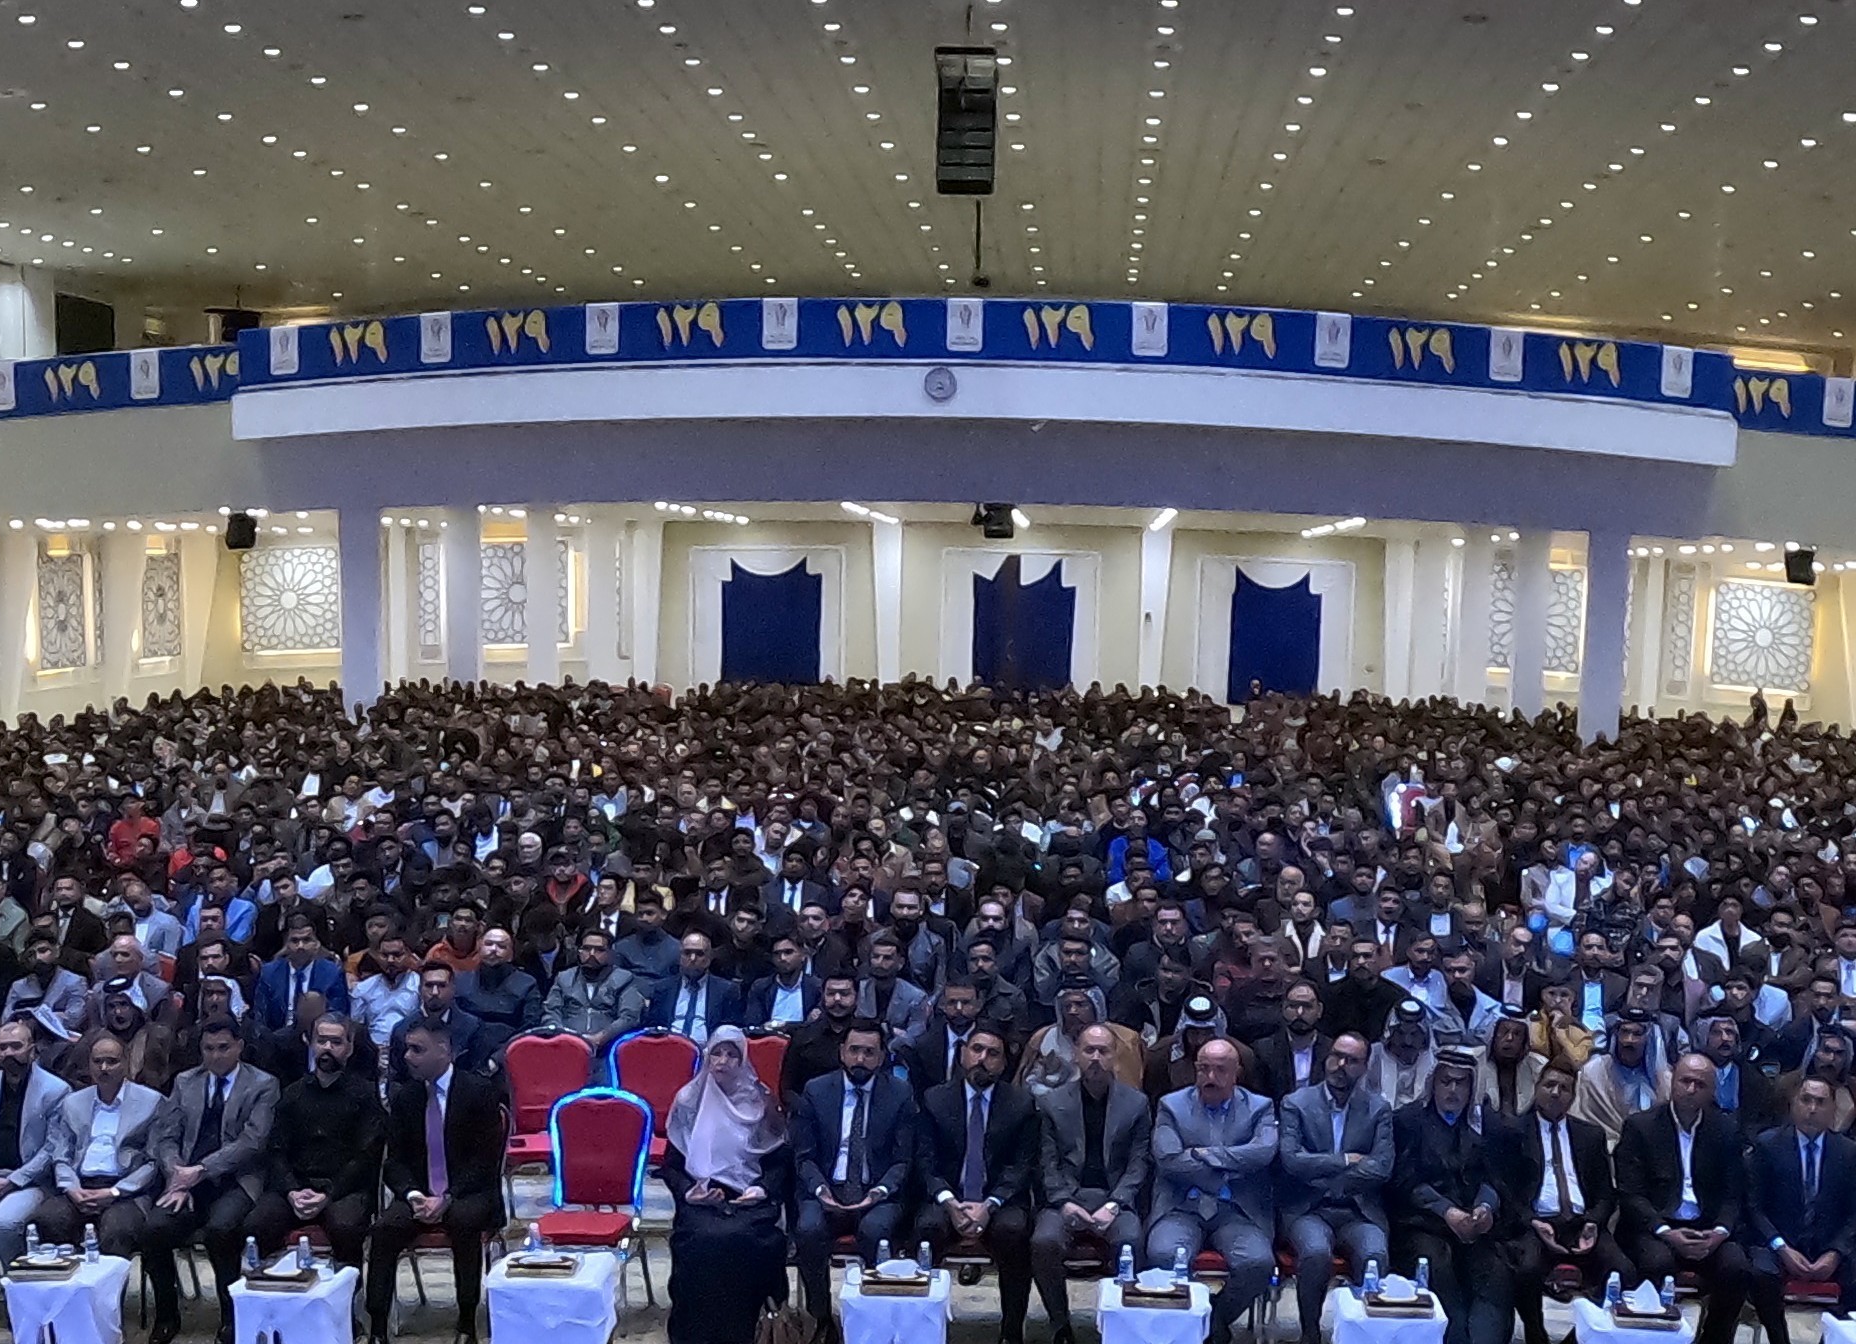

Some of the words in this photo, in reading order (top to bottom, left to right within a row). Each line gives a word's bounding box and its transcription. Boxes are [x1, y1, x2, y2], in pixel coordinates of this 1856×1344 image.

[330, 320, 387, 367] ١٢٩
[486, 309, 550, 356] ١٢٩
[658, 302, 723, 351] ١٢٩
[838, 301, 907, 348] ١٢٩
[1023, 304, 1093, 351] ١٢٩
[1208, 312, 1274, 359] ١٢٩
[1390, 328, 1454, 374] ١٢٩
[1560, 342, 1619, 388] ١٢٩
[45, 361, 100, 402] ١٢٩
[1734, 377, 1790, 418] ١٢٩
